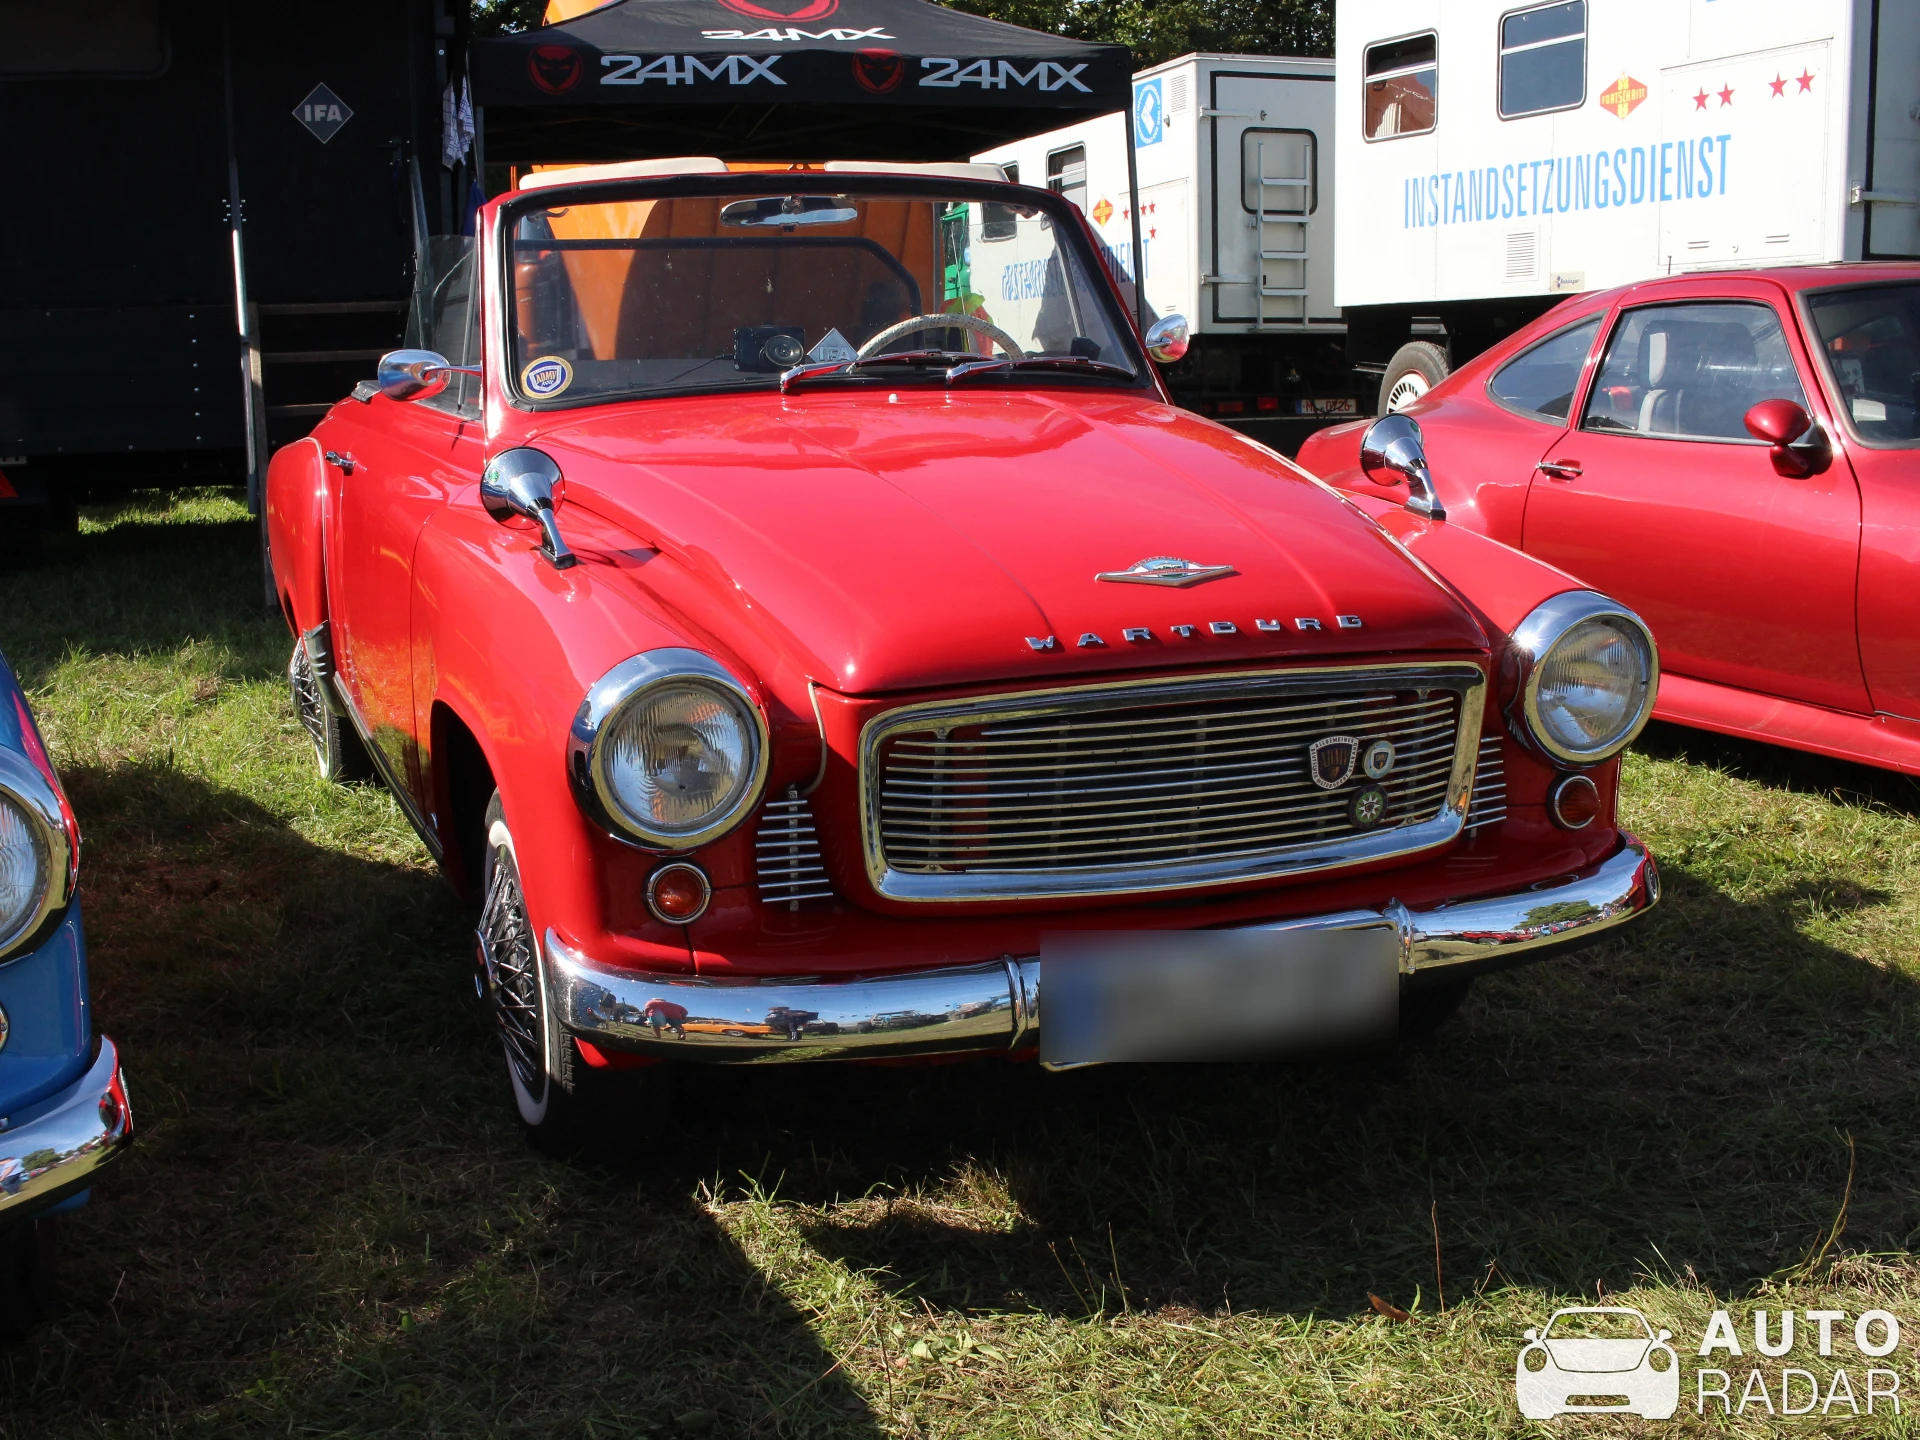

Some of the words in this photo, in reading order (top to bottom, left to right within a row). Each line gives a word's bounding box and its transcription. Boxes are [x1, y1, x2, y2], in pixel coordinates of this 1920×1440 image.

[701, 27, 897, 41] 24MX
[600, 54, 787, 85] 24MX
[918, 57, 1094, 93] 24MX
[304, 104, 343, 122] IFA
[1404, 134, 1732, 229] INSTANDSETZUNGSDIENST
[1024, 614, 1363, 651] WARTBURG
